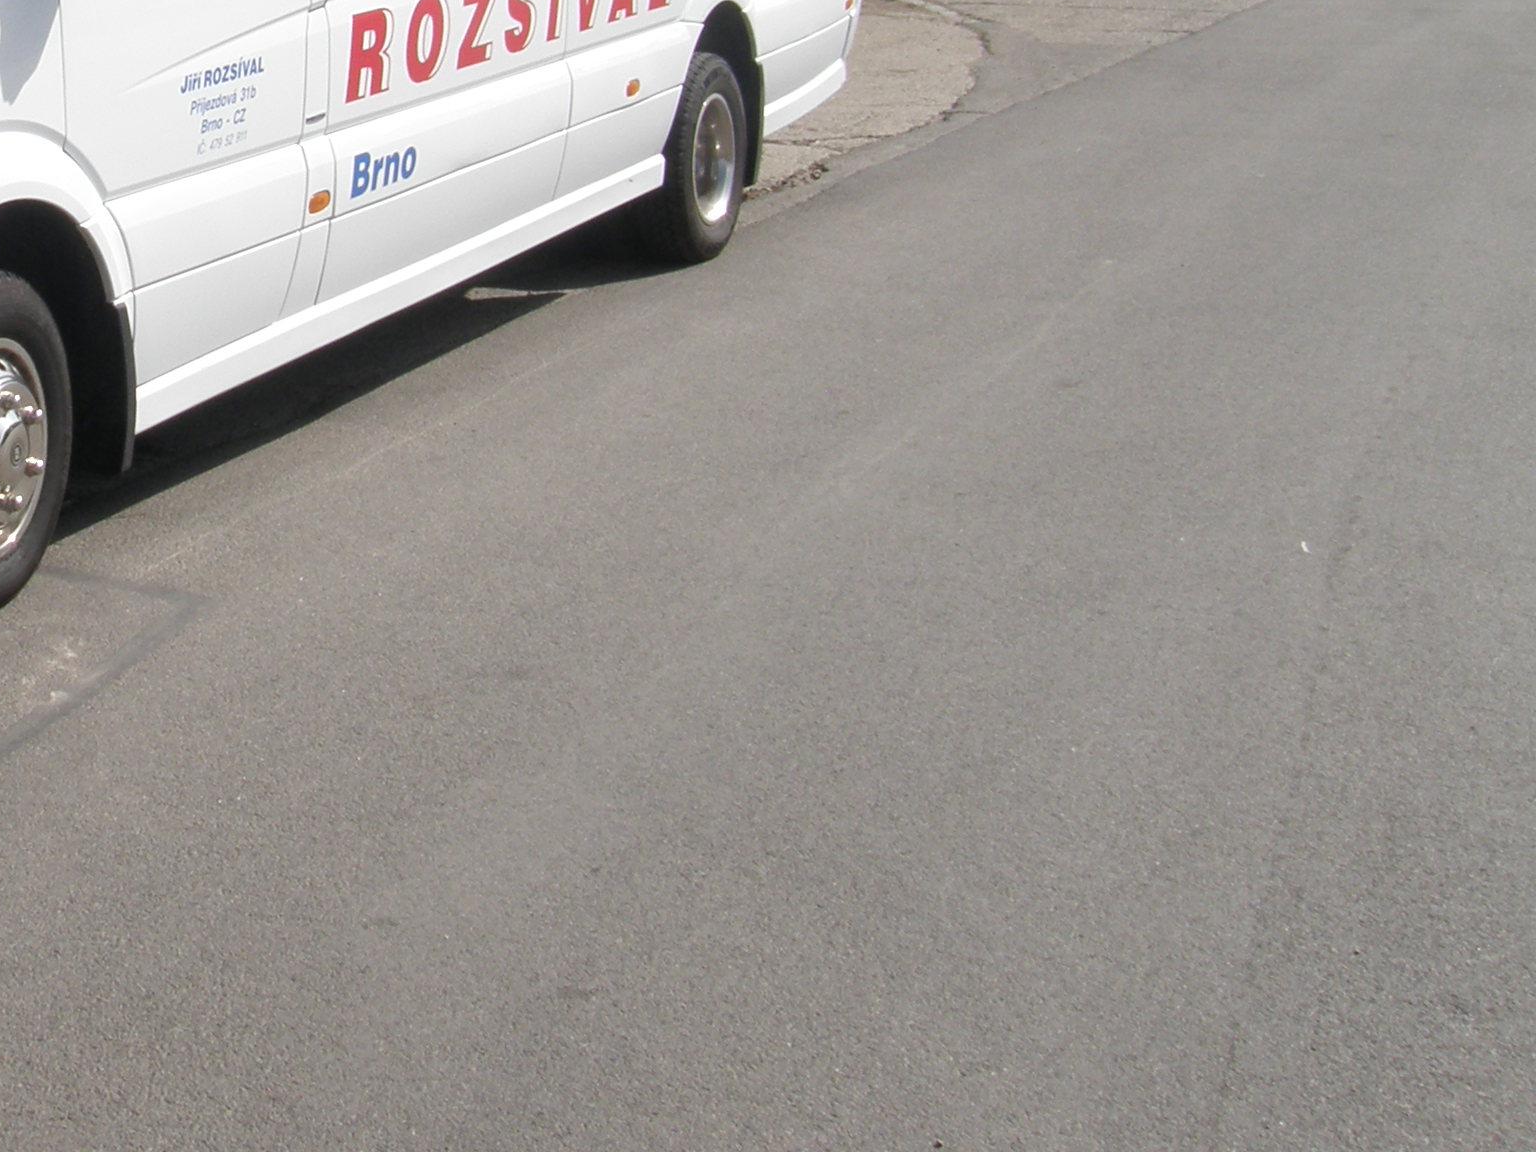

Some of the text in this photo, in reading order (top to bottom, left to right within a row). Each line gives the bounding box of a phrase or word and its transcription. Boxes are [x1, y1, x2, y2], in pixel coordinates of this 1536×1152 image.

[180, 56, 265, 94] Jiří ROZSÍVAL
[201, 118, 223, 134] Brno
[233, 108, 246, 124] CZ
[350, 146, 417, 199] Brno
